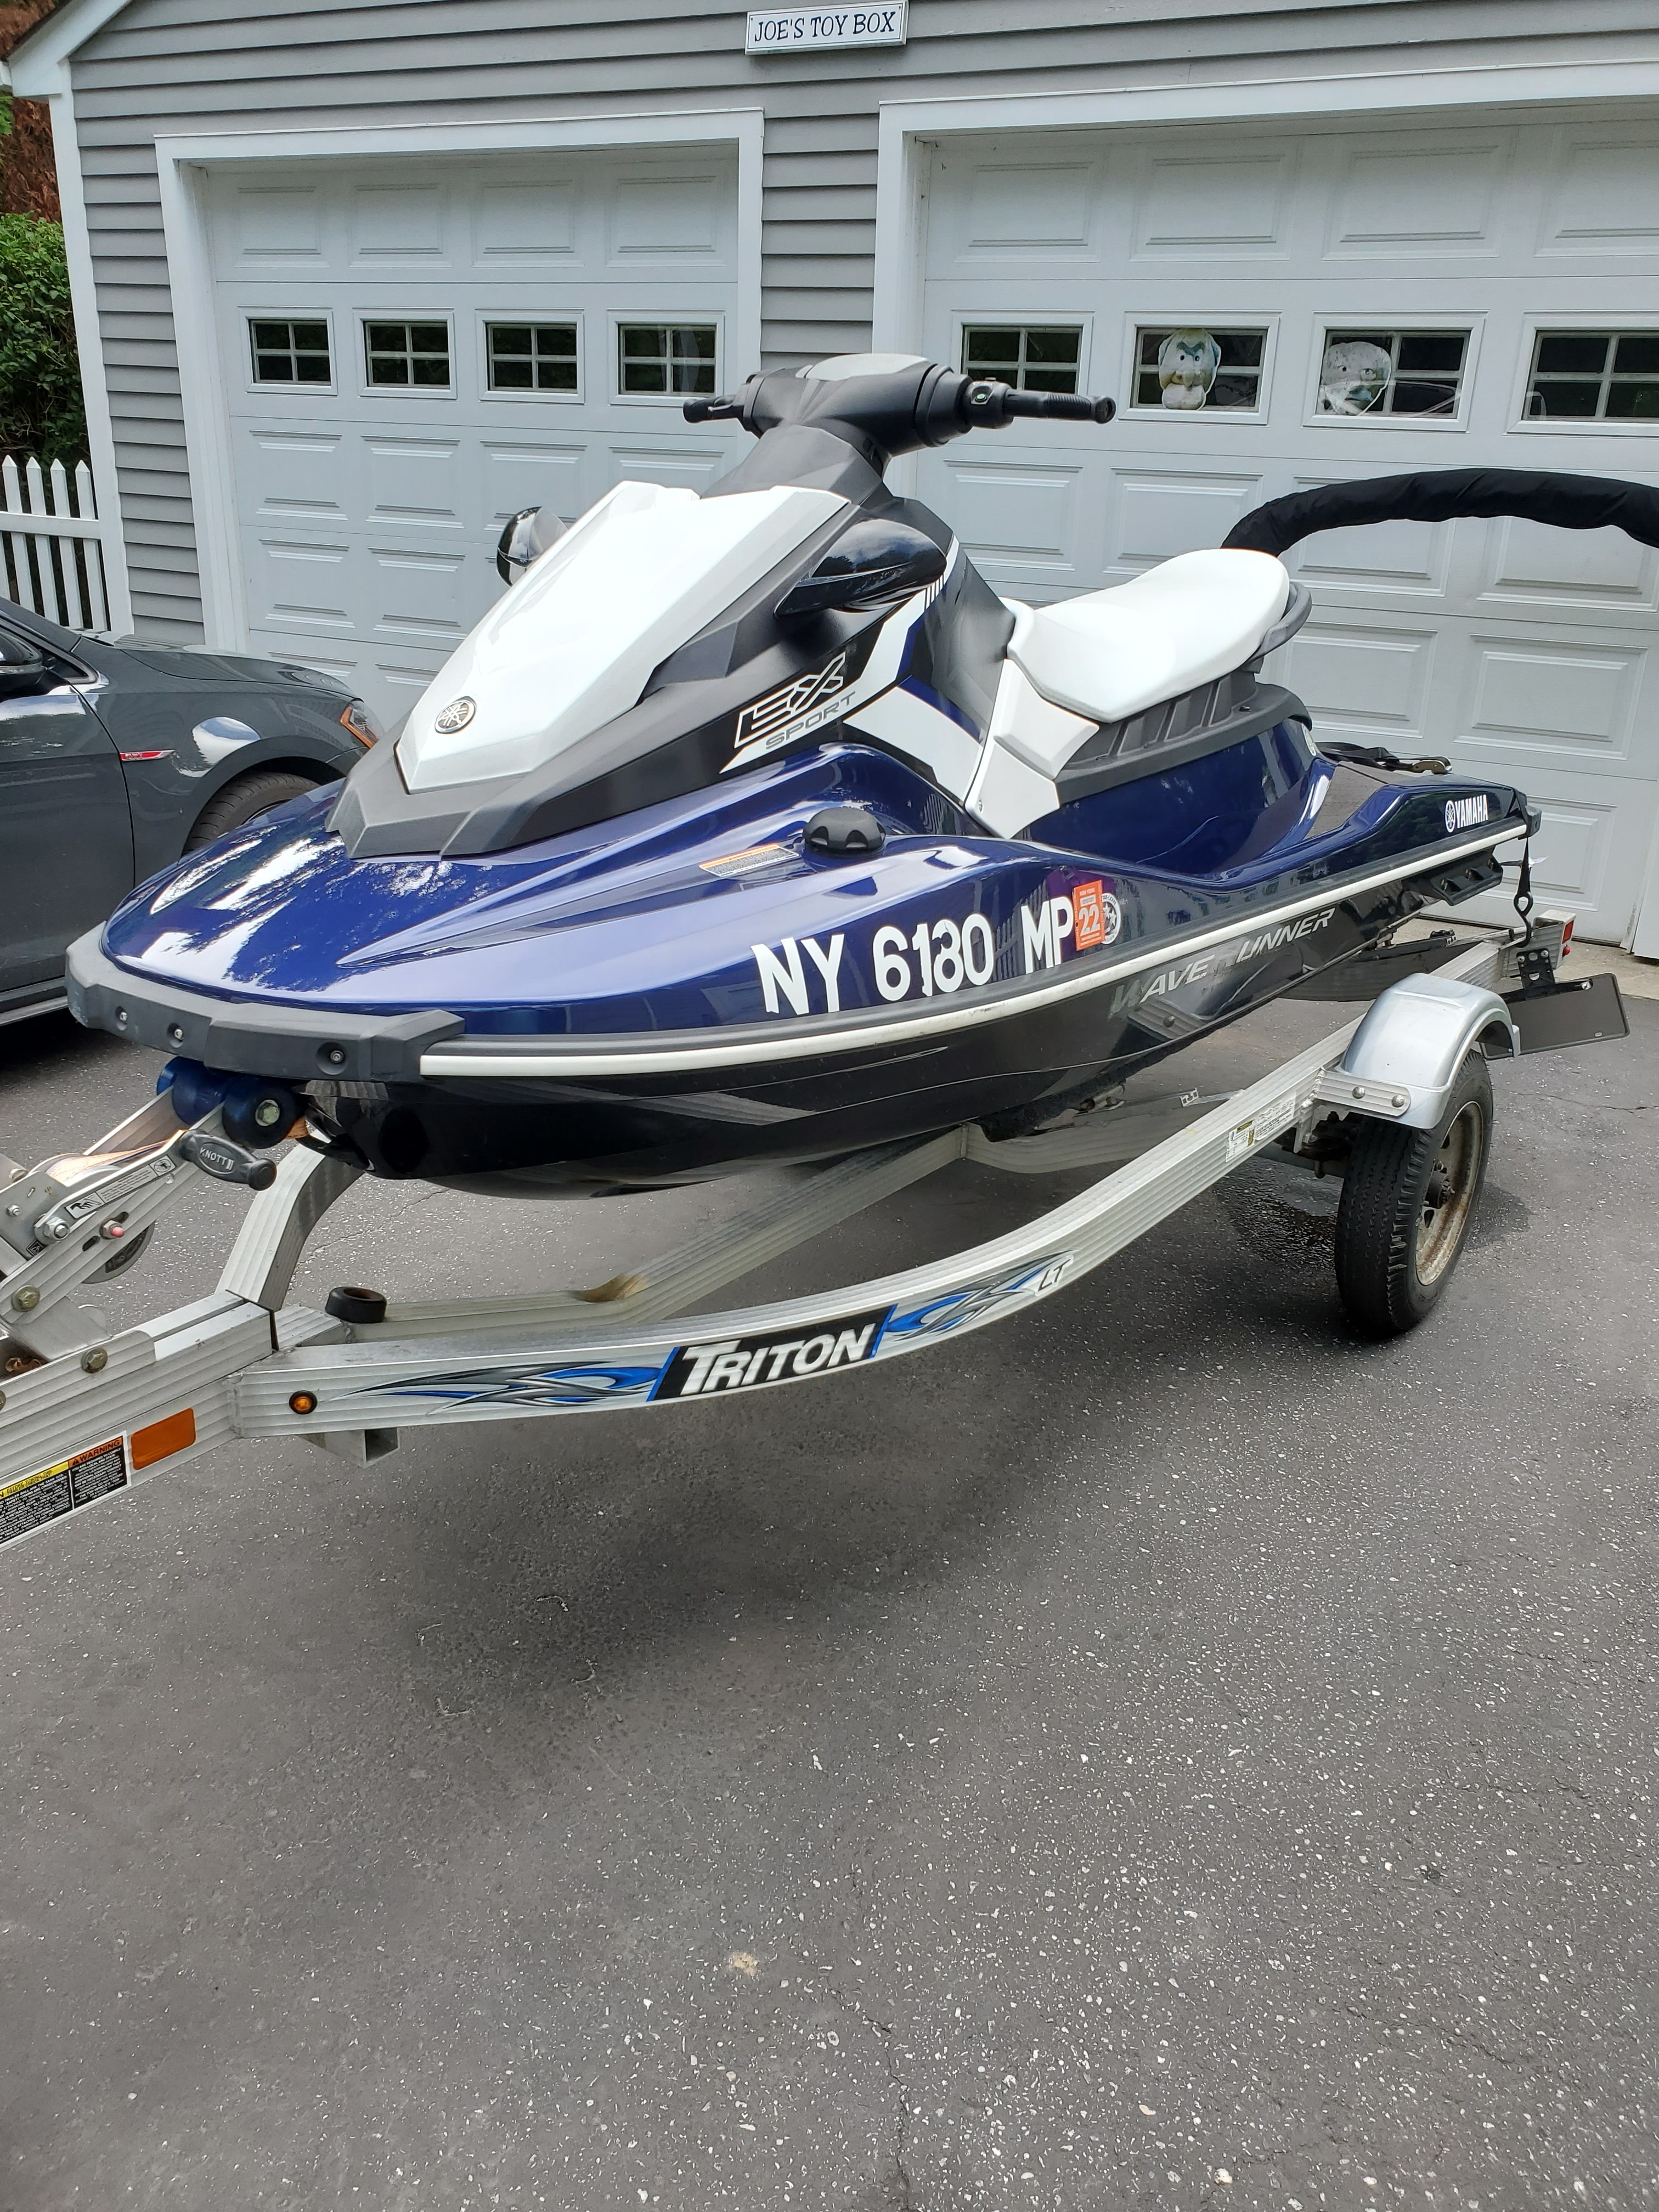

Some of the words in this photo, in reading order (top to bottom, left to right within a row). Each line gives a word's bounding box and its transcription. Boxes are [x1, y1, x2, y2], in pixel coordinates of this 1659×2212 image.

[754, 17, 805, 42] JOE'S
[810, 14, 848, 37] TOY
[853, 11, 896, 34] BOX
[765, 690, 856, 750] SPORT
[1454, 794, 1488, 828] YAMAHA
[1079, 904, 1101, 937] 22
[750, 933, 845, 1015] NY
[872, 913, 994, 1002] 6180
[1020, 896, 1074, 974] MP
[200, 1147, 228, 1165] KNOTT
[1037, 1259, 1071, 1292] LT
[680, 1323, 876, 1396] TRITON
[80, 1440, 120, 1460] WARNING
